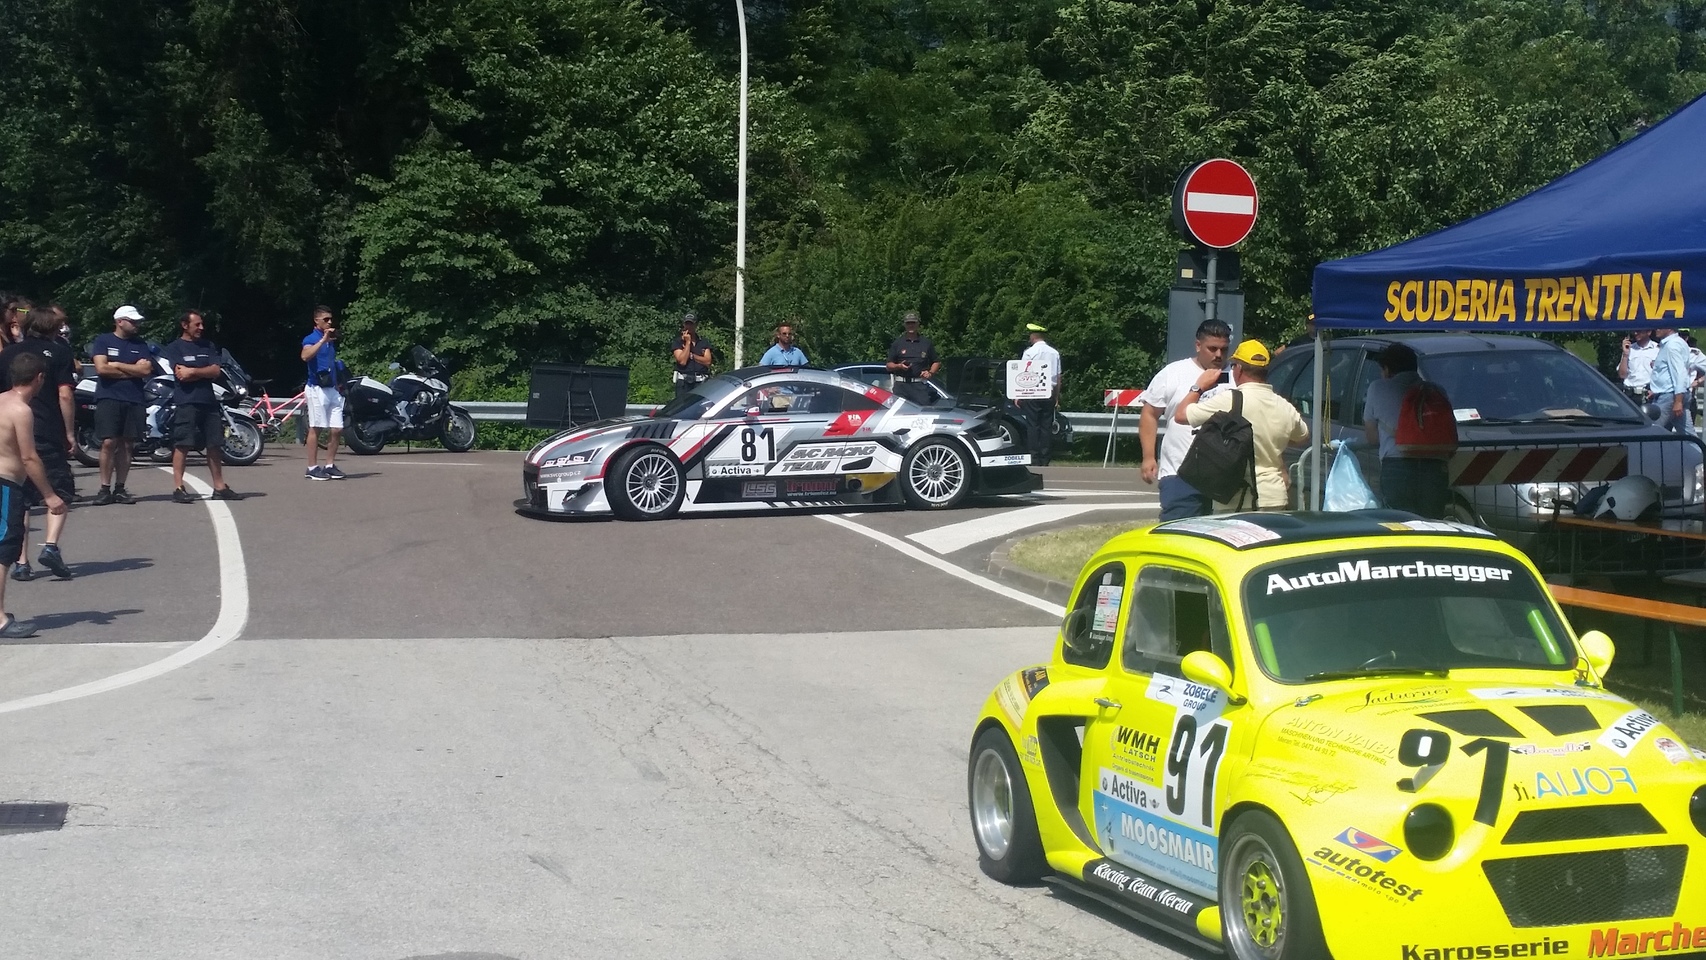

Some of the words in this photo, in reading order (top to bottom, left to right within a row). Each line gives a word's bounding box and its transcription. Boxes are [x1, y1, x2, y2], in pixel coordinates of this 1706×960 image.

[1384, 279, 1516, 323] SCUDERIA
[1523, 270, 1685, 323] TRENTINA
[741, 427, 775, 462] 81
[821, 445, 878, 458] RACING
[720, 465, 752, 475] Activa
[781, 460, 831, 473] TEAM
[1265, 559, 1514, 596] AutoMarchegger
[1182, 683, 1219, 704] ZOBELE
[1182, 698, 1207, 712] GROUP
[1117, 725, 1161, 755] WMH
[1123, 747, 1156, 763] LATSCH
[1286, 716, 1344, 739] ANTON
[1344, 732, 1396, 760] WAIBL
[1166, 714, 1229, 829] 91
[1396, 728, 1510, 828] 91
[1111, 774, 1148, 809] Activa
[1120, 811, 1217, 875] MOOSMAIR
[1093, 862, 1131, 892] Racing
[1127, 877, 1156, 901] Team
[1154, 888, 1194, 915] Meran
[1313, 846, 1424, 902] autotest
[1401, 936, 1569, 960] Karosserie
[1588, 921, 1706, 959] Marche
